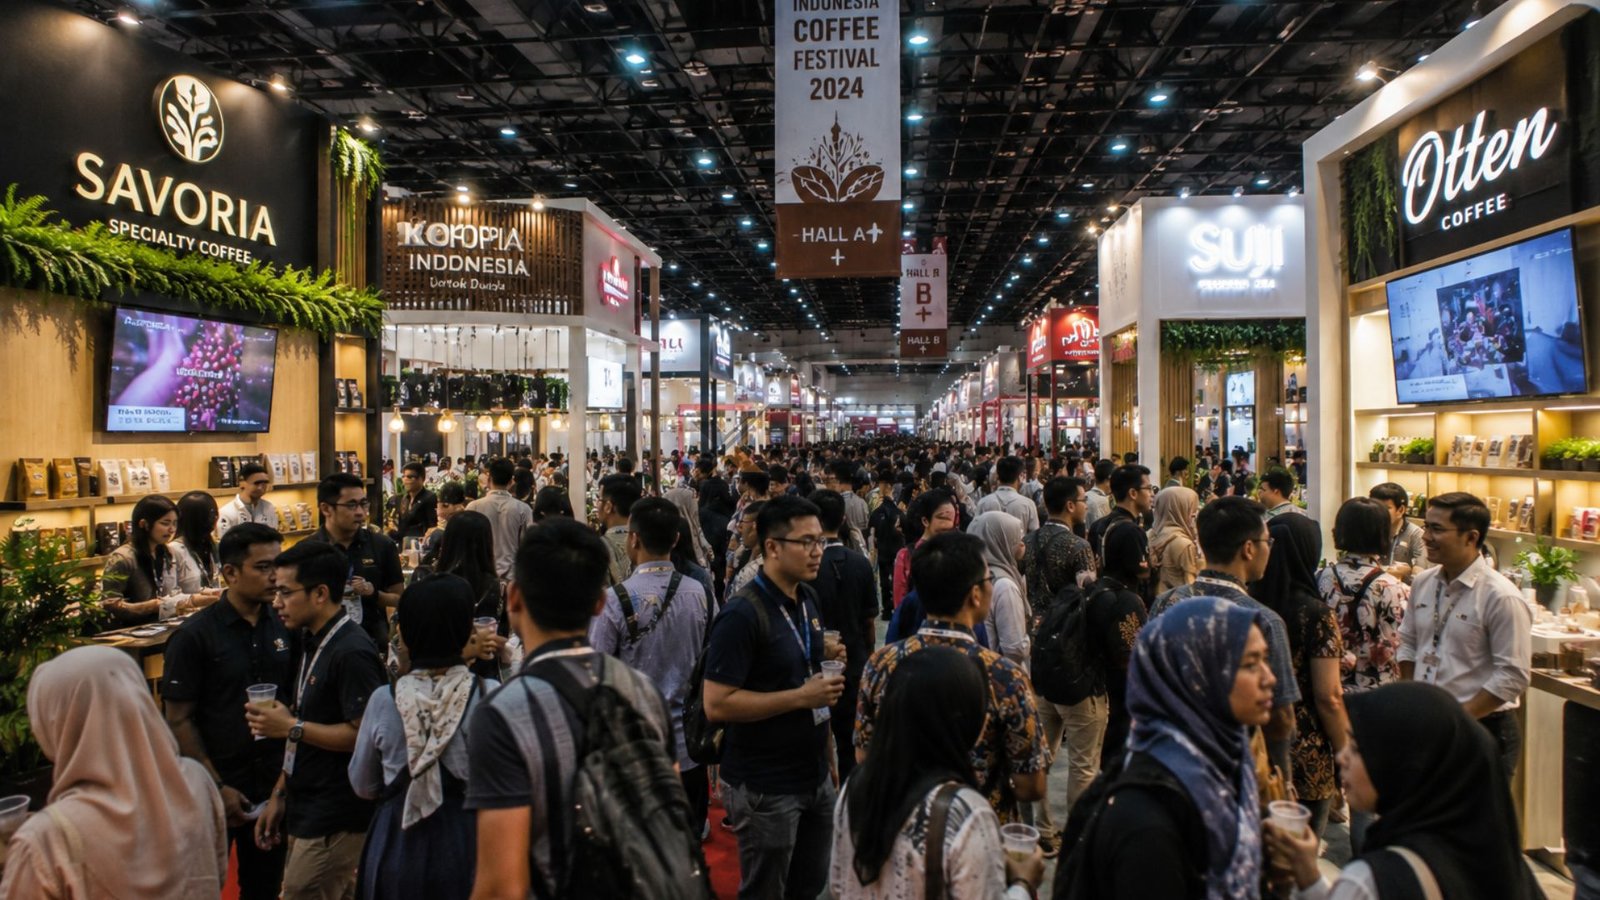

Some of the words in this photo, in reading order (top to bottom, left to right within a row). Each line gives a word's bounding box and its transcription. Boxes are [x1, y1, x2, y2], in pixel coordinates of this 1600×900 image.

[793, 0, 879, 12] INDONESIA
[794, 16, 879, 42] COFFEE
[794, 48, 880, 71] FESTIVAL
[810, 77, 864, 100] 2024
[1402, 107, 1557, 225] Otten
[75, 152, 277, 247] SAVORIA
[1441, 193, 1506, 230] COFFEE
[109, 219, 196, 251] SPECIALTY
[199, 240, 252, 265] COFFEE
[802, 227, 848, 242] HALL
[853, 227, 866, 242] A
[916, 282, 932, 305] B
[907, 336, 931, 345] HALL
